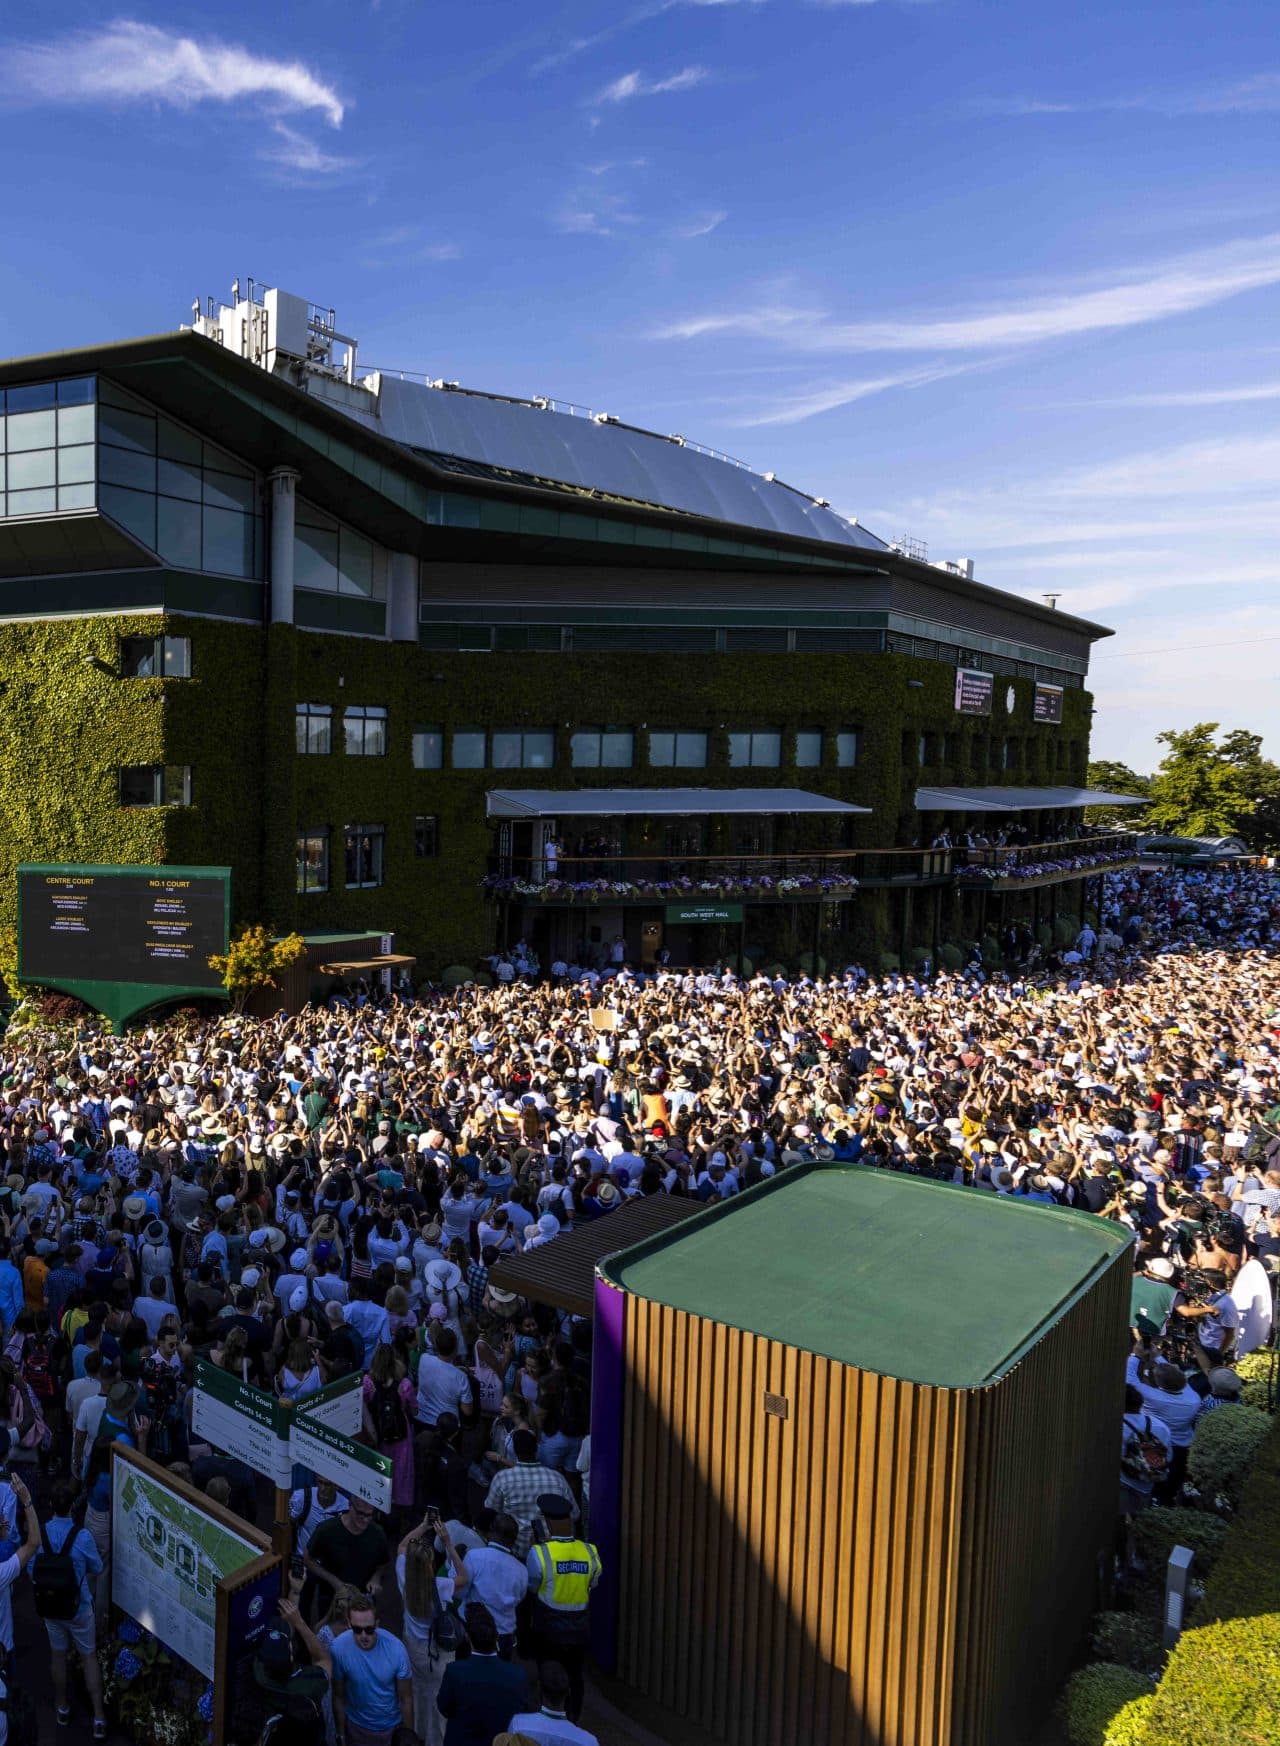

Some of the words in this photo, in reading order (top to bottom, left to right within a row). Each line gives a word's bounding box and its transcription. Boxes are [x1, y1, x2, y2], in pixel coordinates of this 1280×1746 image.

[234, 1399, 254, 1416] Courts
[255, 1395, 272, 1410] Court
[296, 1399, 314, 1411] Courts
[296, 1417, 317, 1434] Courts
[319, 1429, 324, 1437] 2
[324, 1435, 338, 1445] and
[249, 1439, 260, 1451] The
[261, 1447, 271, 1457] Hill
[296, 1432, 325, 1455] Southern
[326, 1450, 350, 1470] Village
[558, 1561, 588, 1574] SECURITY
